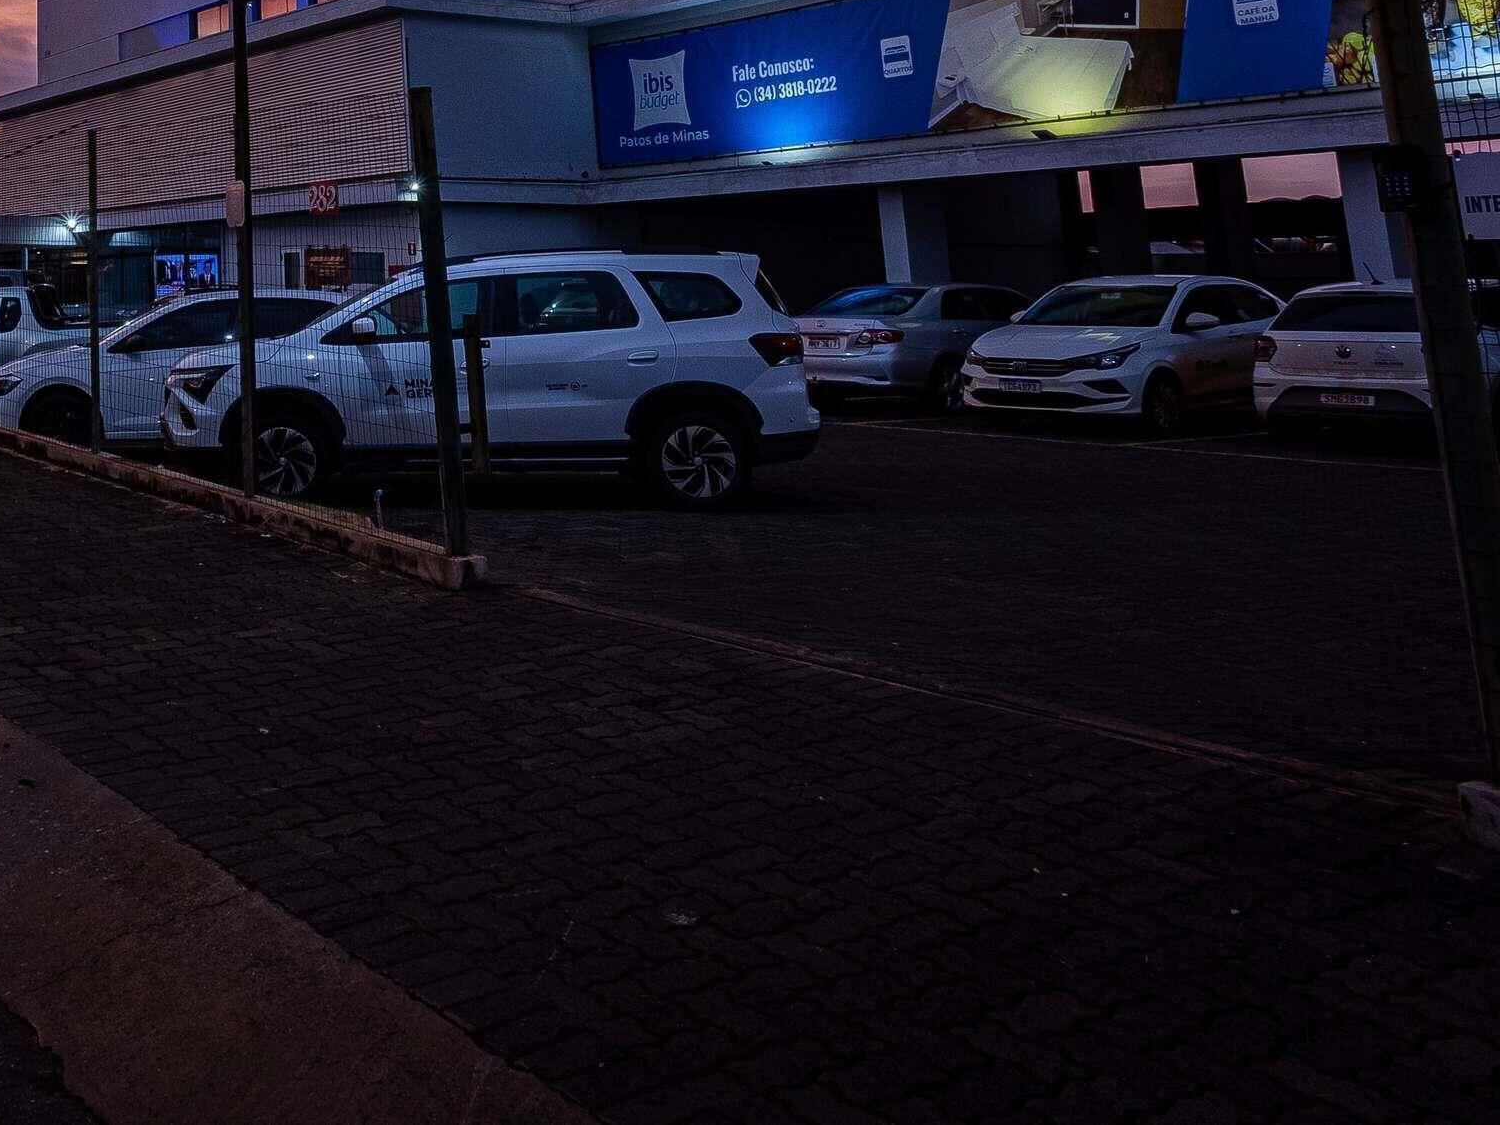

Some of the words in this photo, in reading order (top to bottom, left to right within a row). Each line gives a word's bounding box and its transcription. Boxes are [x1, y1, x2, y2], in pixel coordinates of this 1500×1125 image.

[732, 63, 756, 83] Fale
[758, 57, 815, 79] Conosco:
[643, 71, 674, 94] ibis
[754, 84, 777, 102] (34)
[778, 75, 837, 99] 3818-0222
[640, 91, 680, 110] budget
[619, 135, 652, 148] Patos
[654, 132, 670, 145] de
[672, 128, 711, 143] Minas
[308, 185, 336, 212] 282
[404, 378, 435, 389] MINA
